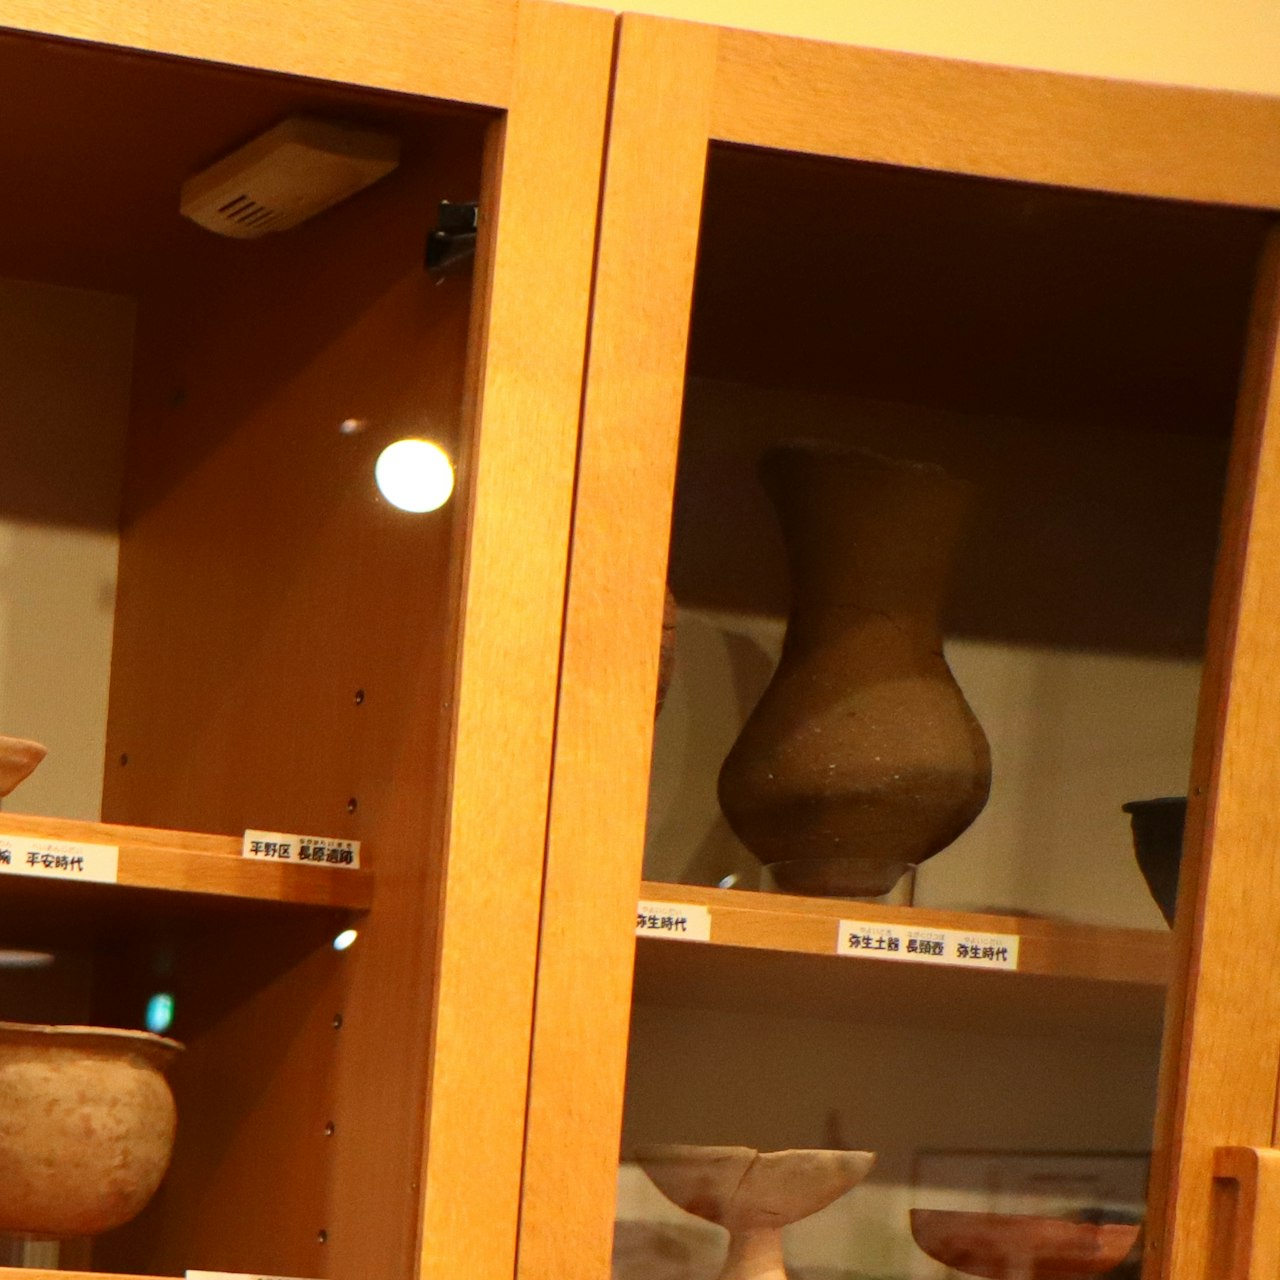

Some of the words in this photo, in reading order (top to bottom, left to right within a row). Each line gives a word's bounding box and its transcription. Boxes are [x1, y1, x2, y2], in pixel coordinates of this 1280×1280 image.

[26, 852, 85, 872] 平安時代
[250, 841, 291, 859] 平野区
[298, 845, 354, 865] 長原遺跡
[848, 933, 900, 952] 弥生土器
[957, 943, 1008, 962] 弥生時代
